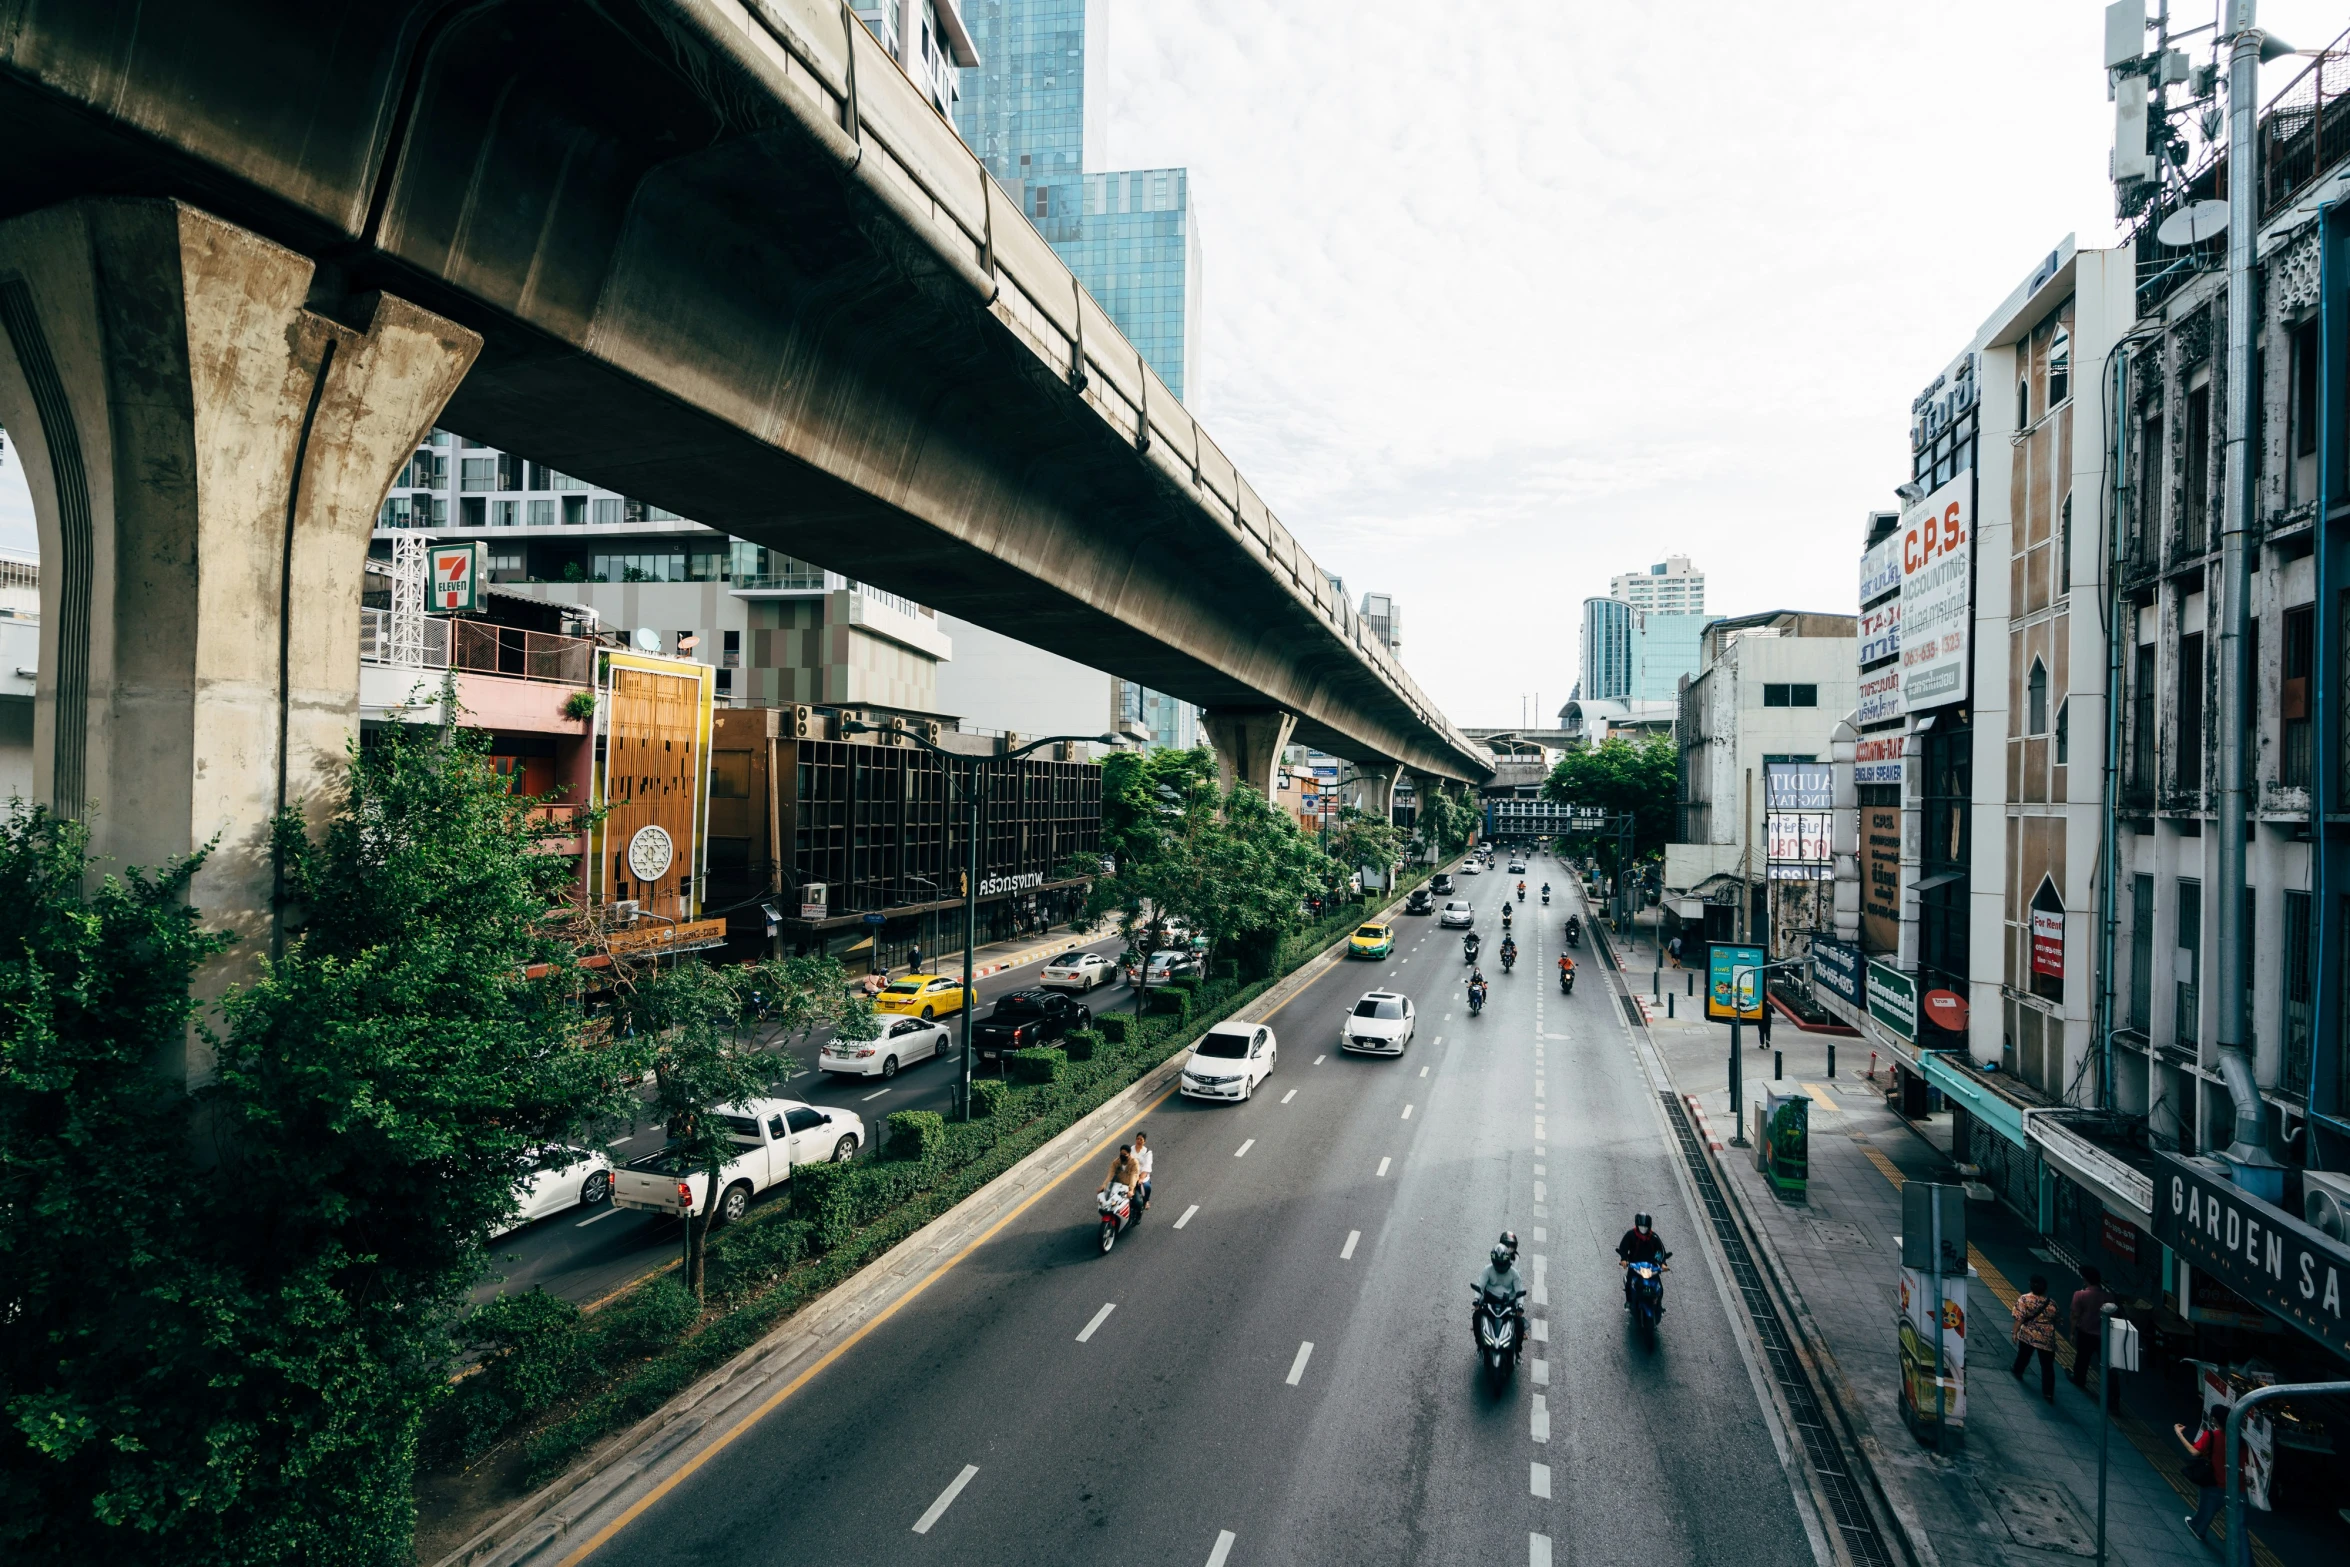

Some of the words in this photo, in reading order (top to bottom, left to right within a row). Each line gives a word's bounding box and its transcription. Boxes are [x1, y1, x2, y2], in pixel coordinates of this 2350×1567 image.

[1904, 501, 1966, 575] C.P.S.
[1902, 552, 1966, 604] ACCOUNTING
[1904, 632, 1961, 667] 063-635-323
[1855, 767, 1875, 781] ENGLISH
[979, 872, 1043, 898] ครัวกรุงเทพ
[2035, 916, 2045, 928] For
[2047, 918, 2062, 931] Rent
[2171, 1175, 2283, 1281] GARDEN
[2298, 1251, 2342, 1320] SA
